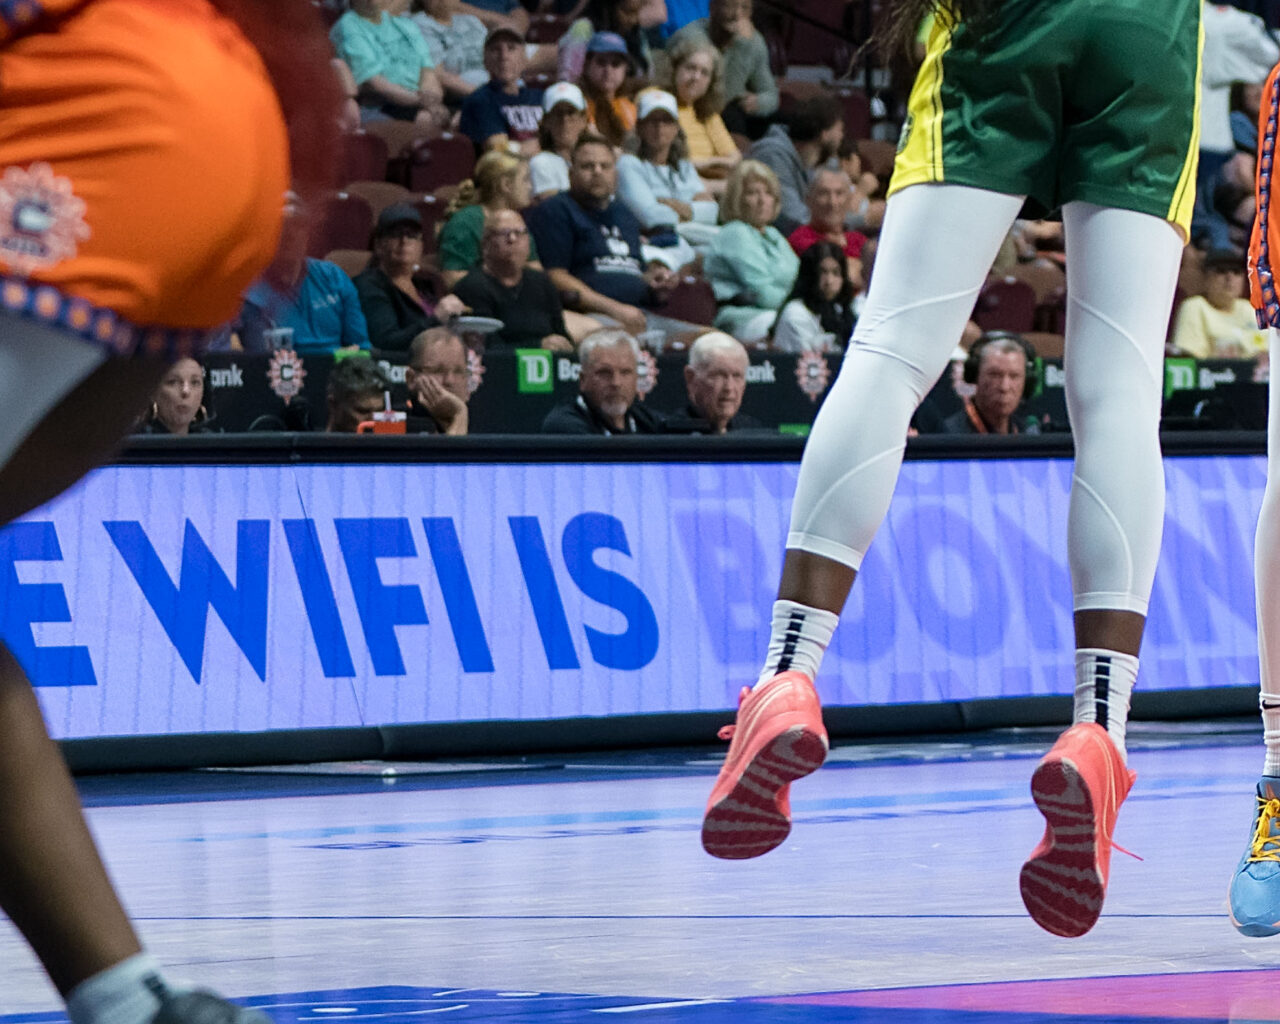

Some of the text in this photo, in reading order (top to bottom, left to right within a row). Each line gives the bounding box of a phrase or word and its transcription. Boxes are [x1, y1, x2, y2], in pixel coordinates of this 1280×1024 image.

[211, 364, 243, 387] ank
[521, 356, 549, 383] TD
[746, 360, 776, 382] ank
[102, 517, 496, 685] WIFI
[508, 511, 660, 671] IS
